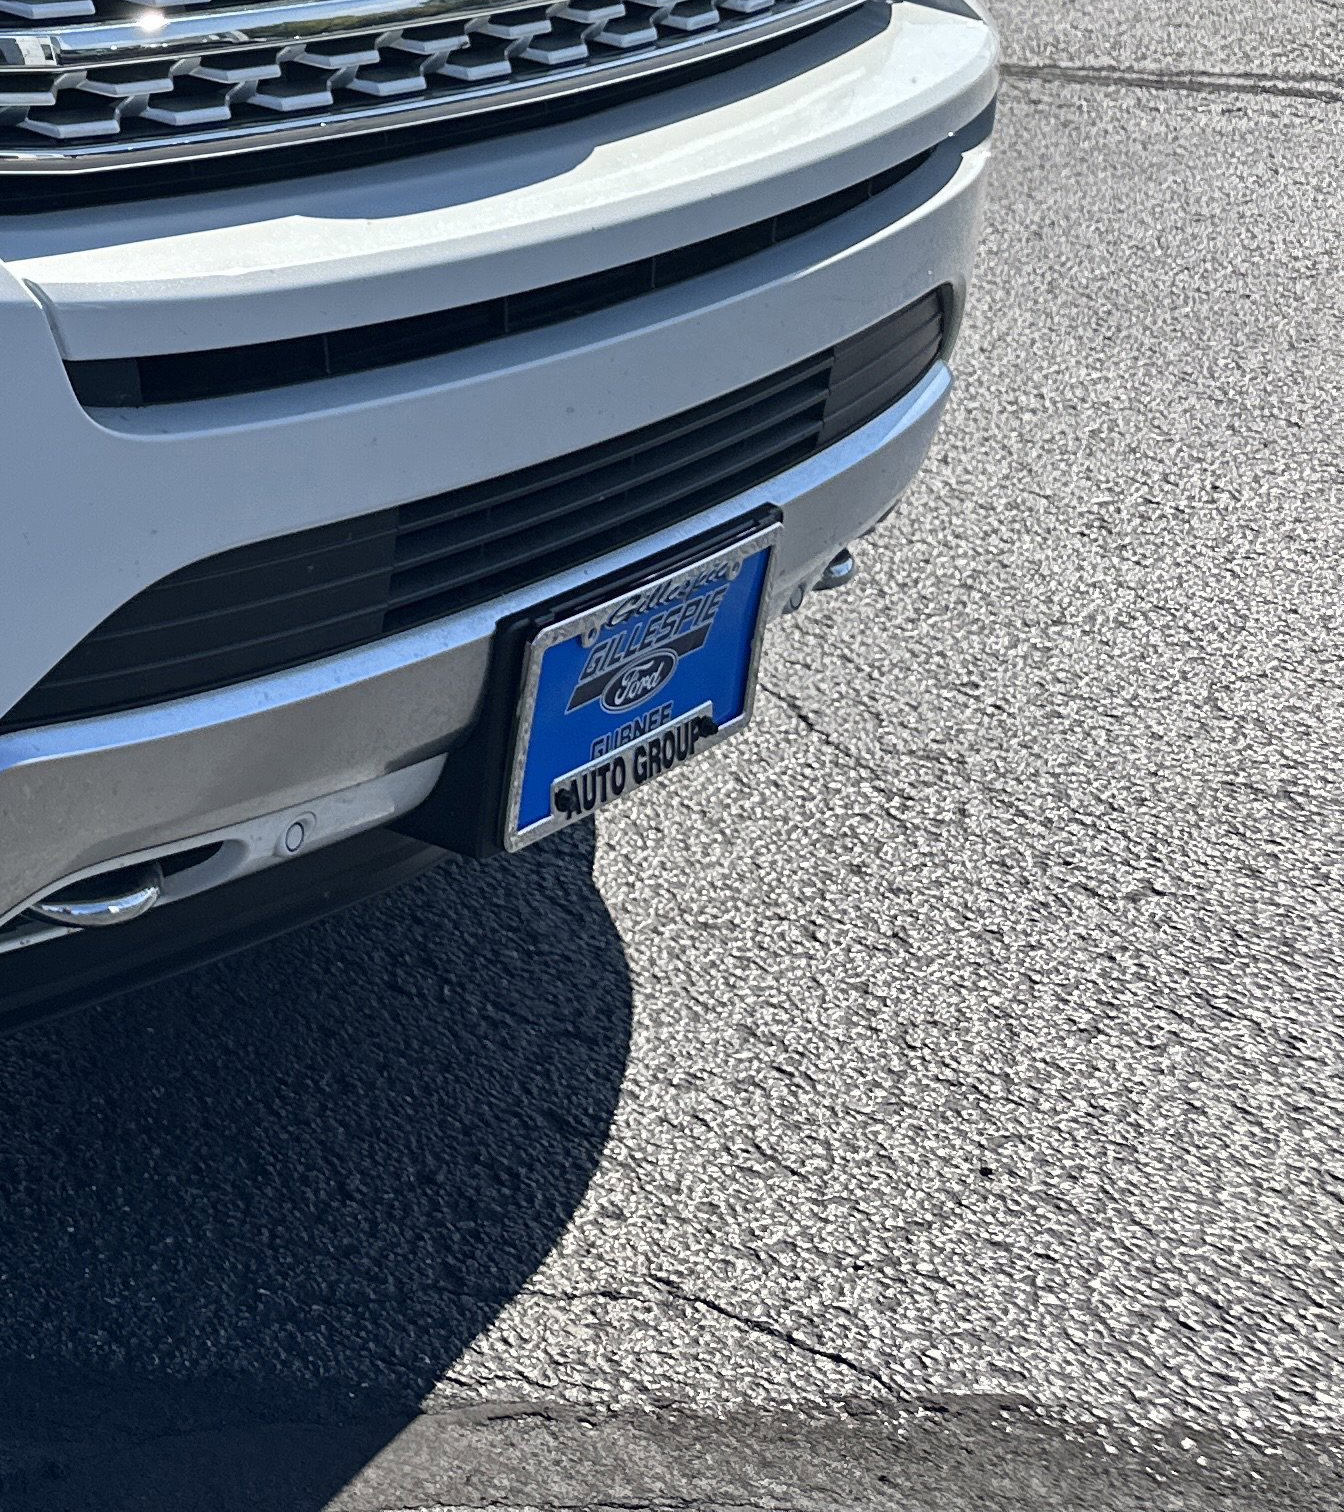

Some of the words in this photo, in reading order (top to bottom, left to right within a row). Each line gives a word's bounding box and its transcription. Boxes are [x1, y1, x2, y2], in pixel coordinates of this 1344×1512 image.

[578, 583, 730, 681] GILLESPIE
[614, 659, 662, 705] Ford
[565, 756, 626, 820] AUTO
[633, 716, 702, 784] GROUP
